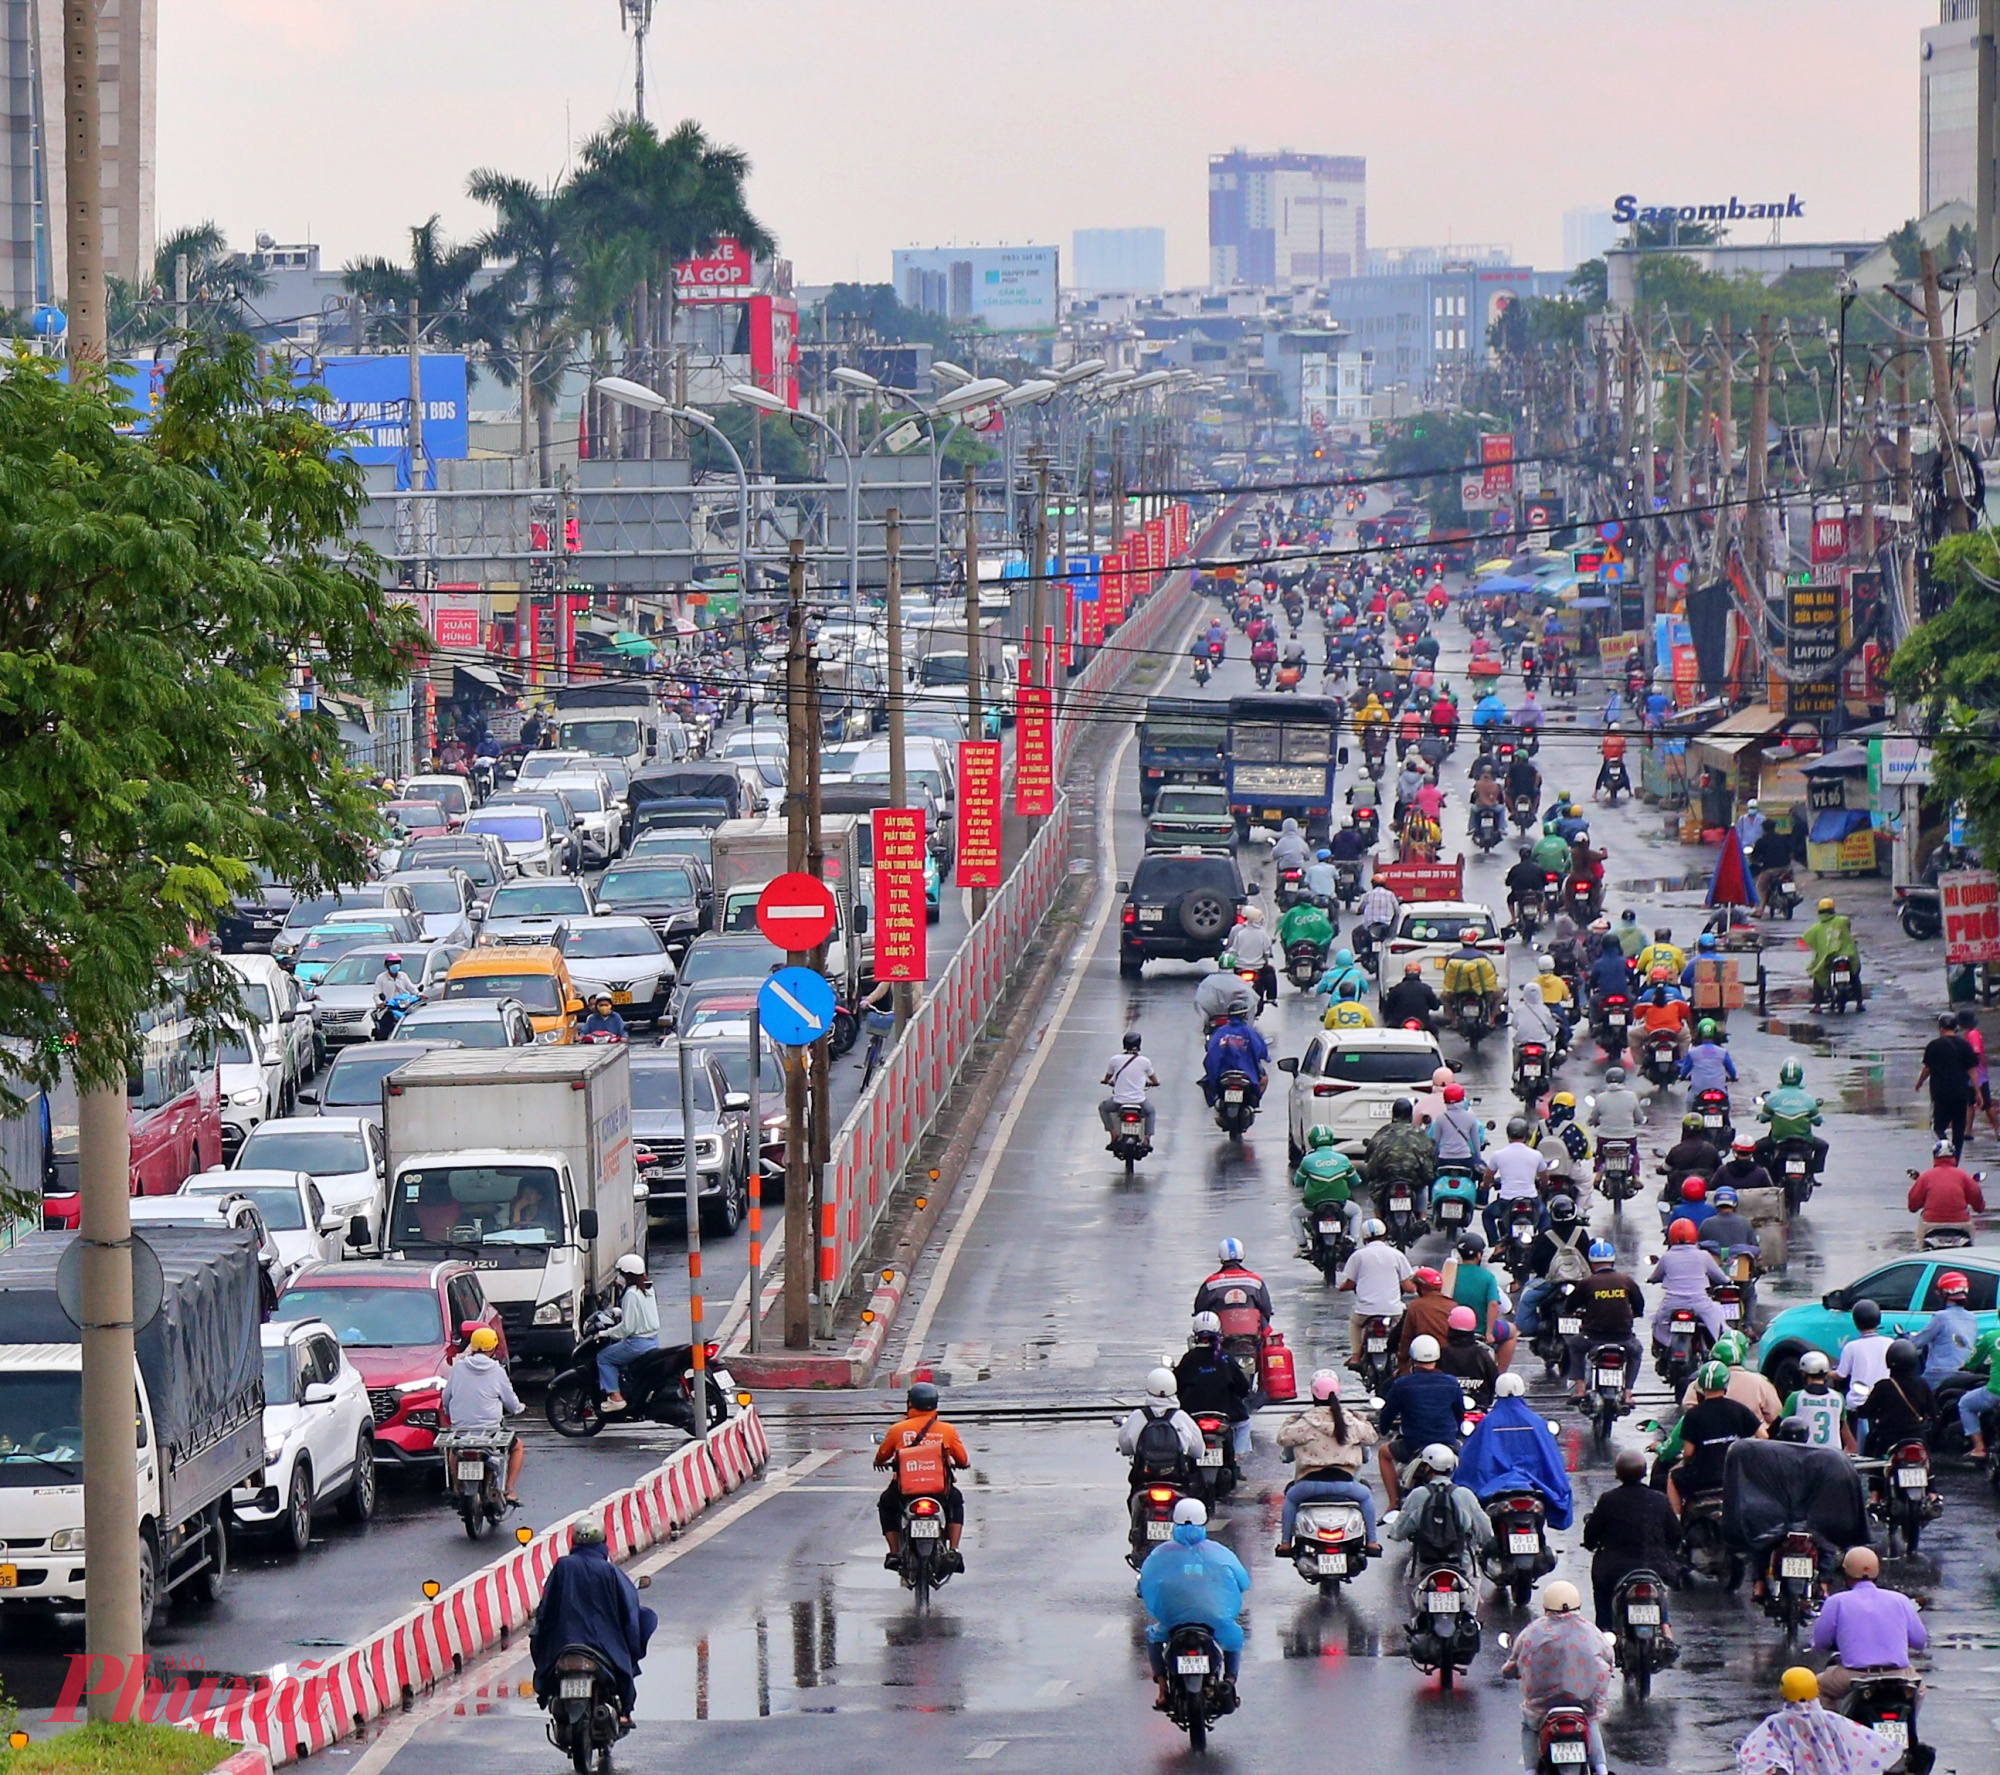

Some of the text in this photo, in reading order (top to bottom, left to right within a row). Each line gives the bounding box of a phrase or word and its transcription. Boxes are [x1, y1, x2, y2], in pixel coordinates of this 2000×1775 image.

[1612, 193, 1806, 223] Sacombank
[699, 263, 742, 283] GÓP
[1819, 525, 1842, 547] NHA
[443, 619, 472, 630] XUÂN
[1794, 645, 1835, 659] LAPTOP
[883, 829, 898, 841] PHÁT
[1294, 911, 1323, 926] Grab
[1653, 947, 1674, 962] be
[1337, 1008, 1362, 1025] be
[1315, 1148, 1339, 1168] Grab
[1594, 1288, 1626, 1301] POLICE
[1813, 1411, 1831, 1445] 3
